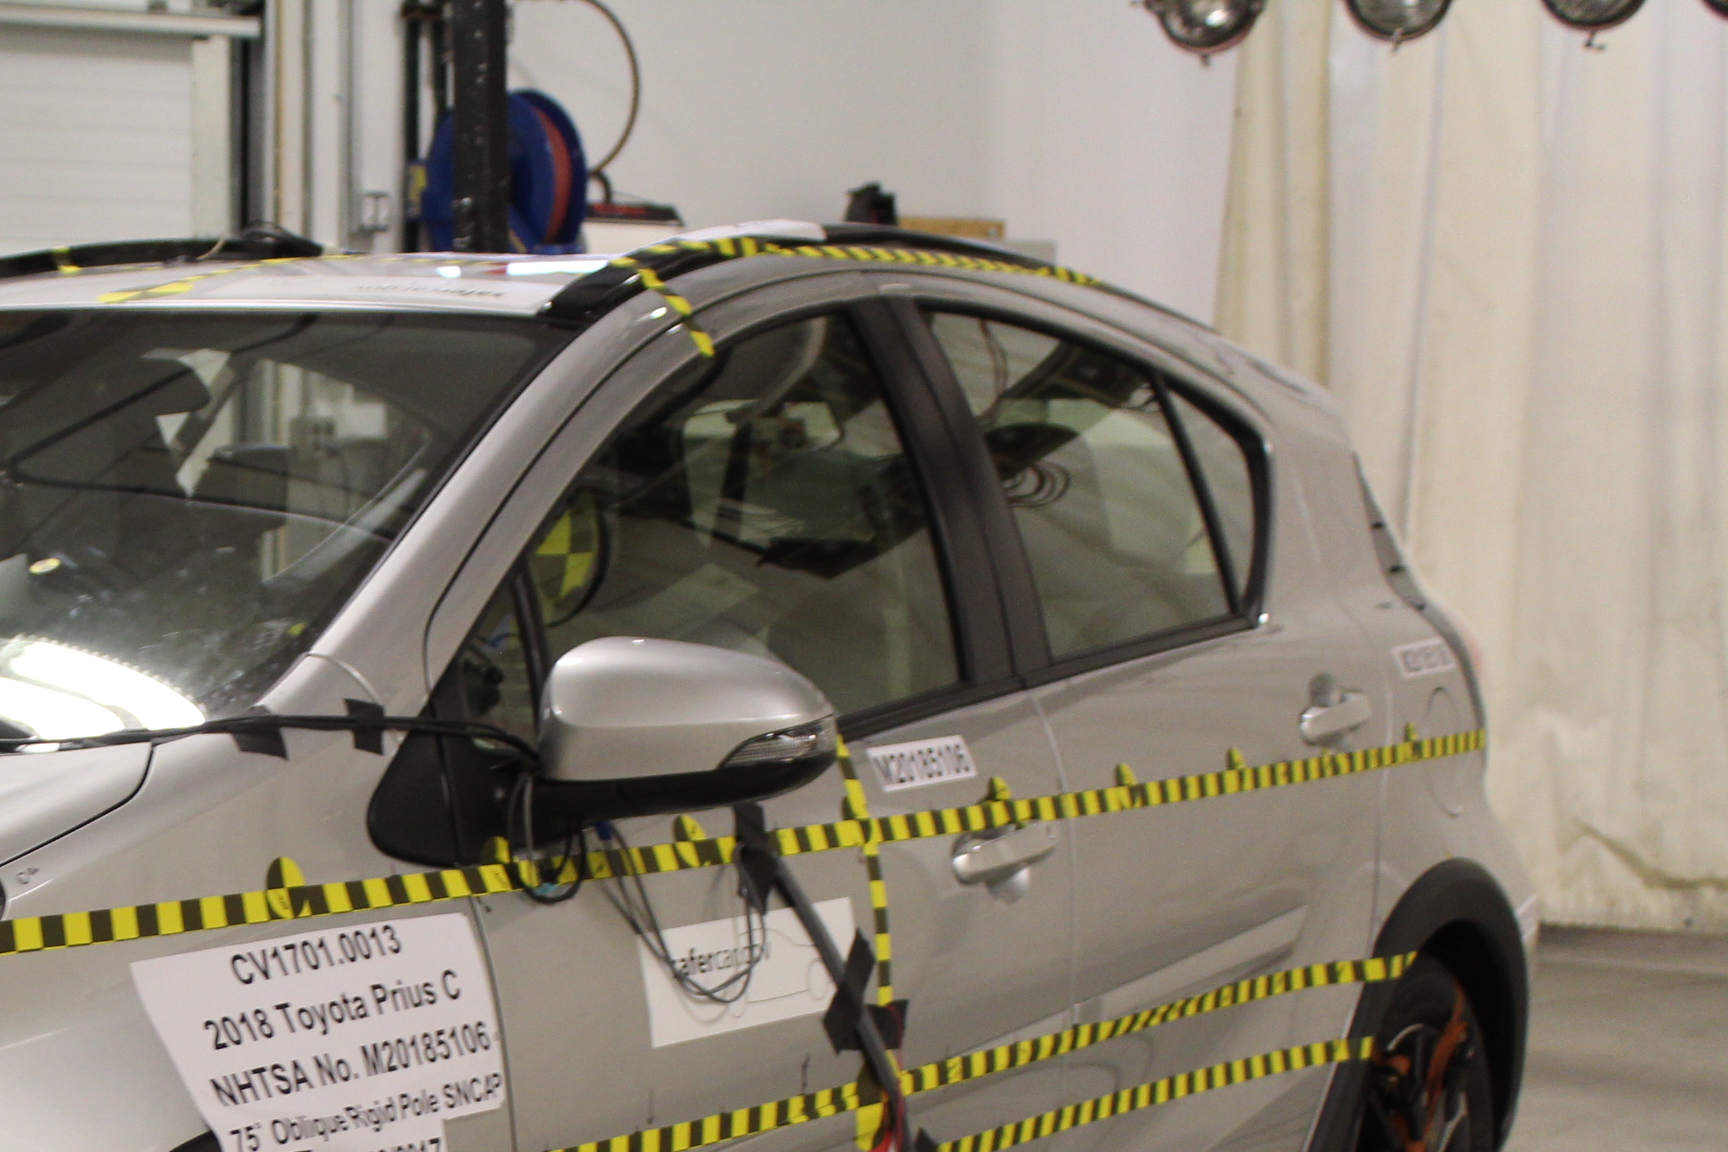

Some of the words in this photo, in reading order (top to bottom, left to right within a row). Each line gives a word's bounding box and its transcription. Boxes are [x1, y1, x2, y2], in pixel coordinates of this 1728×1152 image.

[230, 924, 402, 986] CV1701.0013
[204, 1008, 275, 1050] 2018
[275, 992, 370, 1035] Toyota
[370, 978, 437, 1016] Prius
[441, 968, 462, 1000] C
[209, 1059, 314, 1108] NHTSA
[312, 1051, 359, 1085] No.
[360, 1020, 492, 1077] M20185106
[271, 1106, 350, 1146] Oblique
[344, 1092, 396, 1134] Rigid
[400, 1089, 440, 1118] Pole
[442, 1072, 503, 1110] SNCAP
